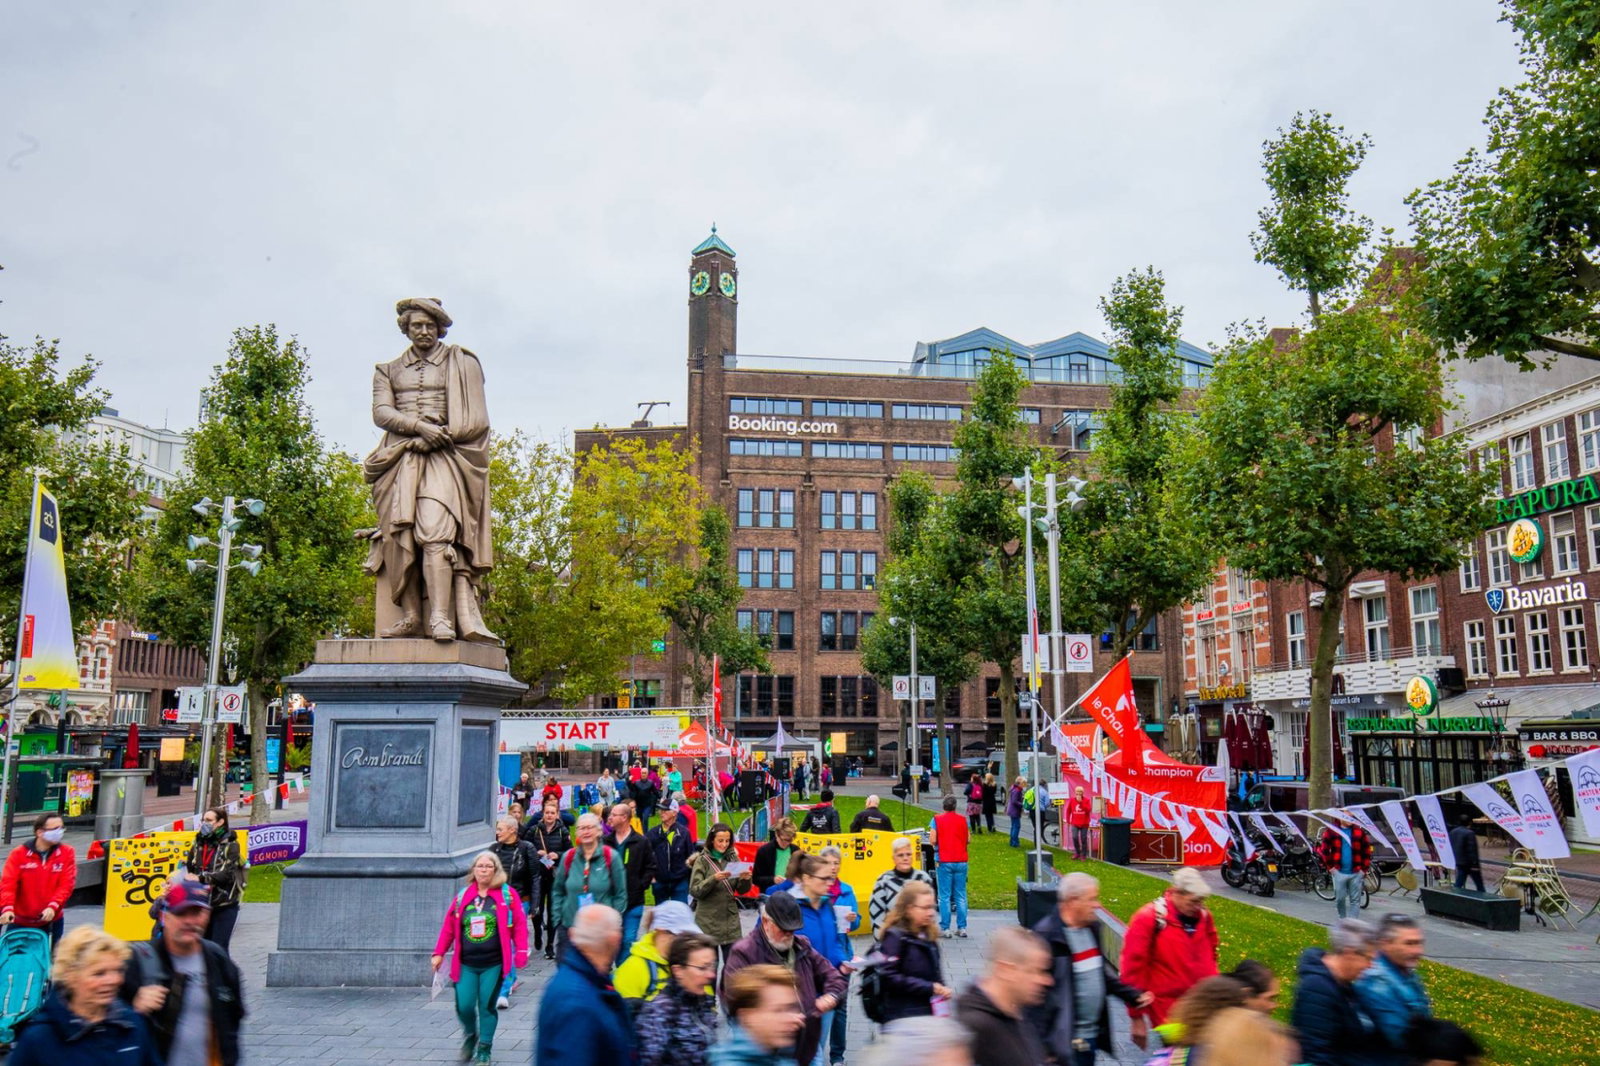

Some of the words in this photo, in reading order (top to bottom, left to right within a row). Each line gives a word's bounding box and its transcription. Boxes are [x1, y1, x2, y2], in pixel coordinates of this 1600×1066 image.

[729, 415, 838, 435] Booking.com
[1506, 577, 1587, 610] Bavaria
[545, 721, 610, 740] START
[1345, 716, 1417, 731] RESTAURANT
[1533, 732, 1557, 740] BAR
[1560, 732, 1568, 740] &
[1571, 731, 1597, 740] BBQ
[341, 743, 424, 769] Rembrandt
[1144, 767, 1193, 778] hampion
[249, 831, 299, 846] JOERTOER
[254, 849, 288, 862] EGMOND
